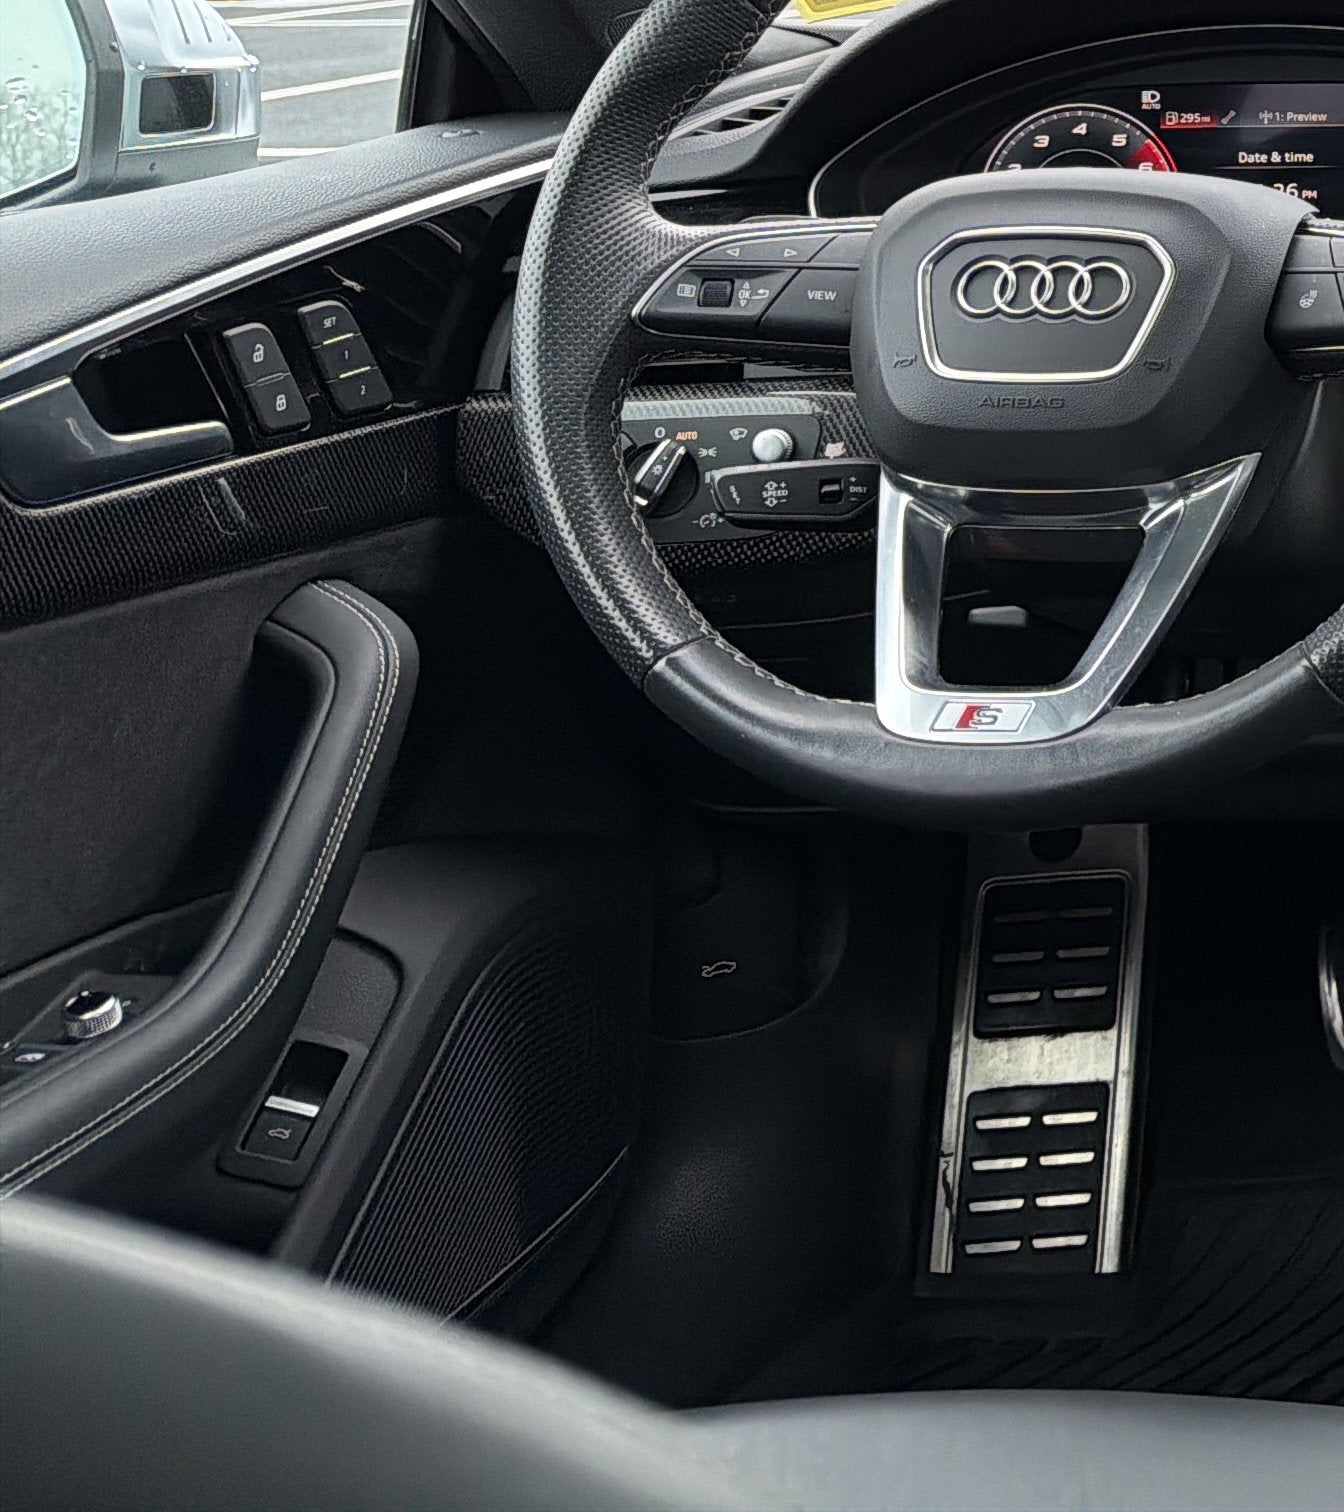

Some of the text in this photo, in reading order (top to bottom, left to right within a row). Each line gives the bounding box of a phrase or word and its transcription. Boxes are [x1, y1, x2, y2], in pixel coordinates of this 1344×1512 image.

[1274, 111, 1328, 123] 1: Preview
[1071, 122, 1088, 136] 4
[1032, 135, 1050, 148] 3
[1111, 134, 1127, 148] 5
[1238, 151, 1315, 163] Date & time
[1301, 190, 1318, 199] PM
[738, 289, 750, 300] OK
[807, 289, 837, 301] VIEW
[323, 316, 336, 329] SET
[360, 385, 366, 396] 2
[979, 396, 1065, 409] AIRBAG
[675, 431, 699, 441] AUTO
[761, 489, 789, 498] SPEED
[849, 486, 868, 494] DIST
